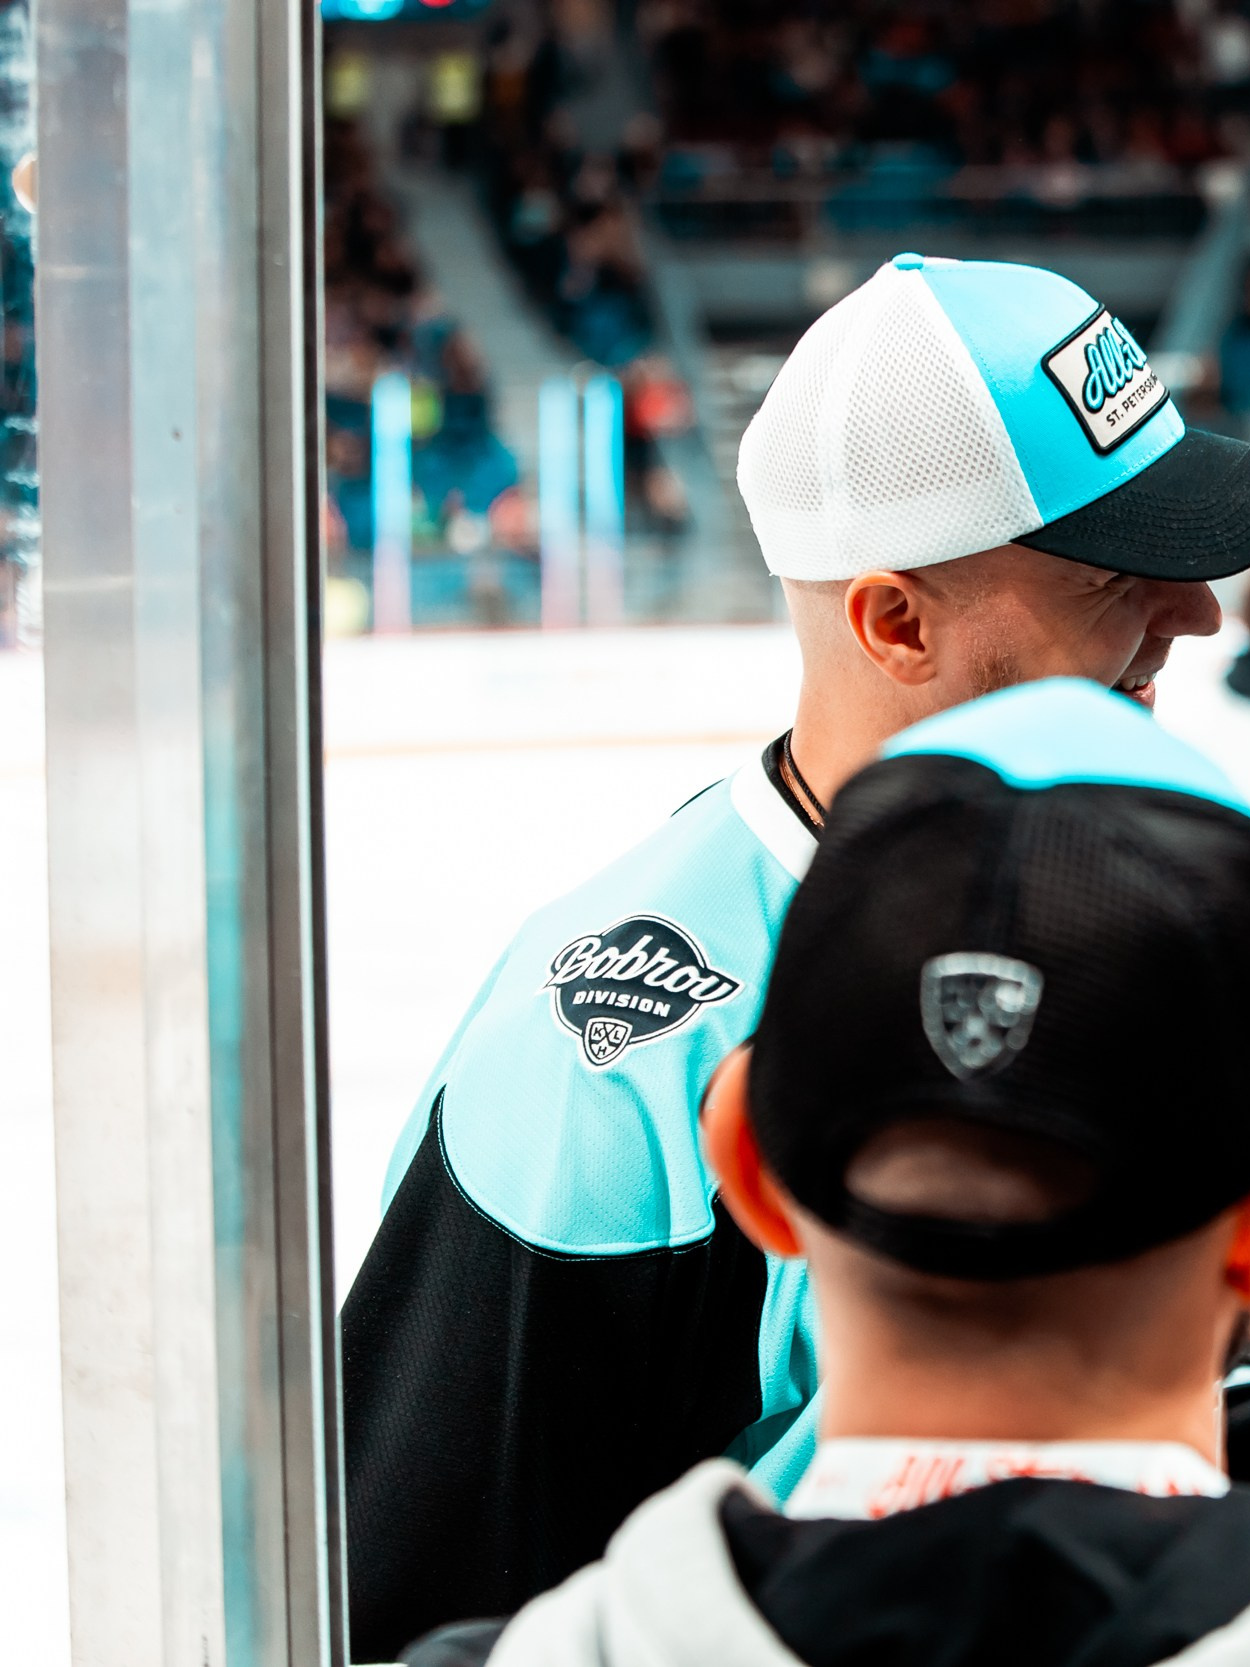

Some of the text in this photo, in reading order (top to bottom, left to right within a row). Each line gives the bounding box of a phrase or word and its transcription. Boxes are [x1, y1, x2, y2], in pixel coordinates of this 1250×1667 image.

[1106, 409, 1124, 427] ST.
[546, 934, 734, 1001] Bobrov
[572, 990, 671, 1018] DIVISION
